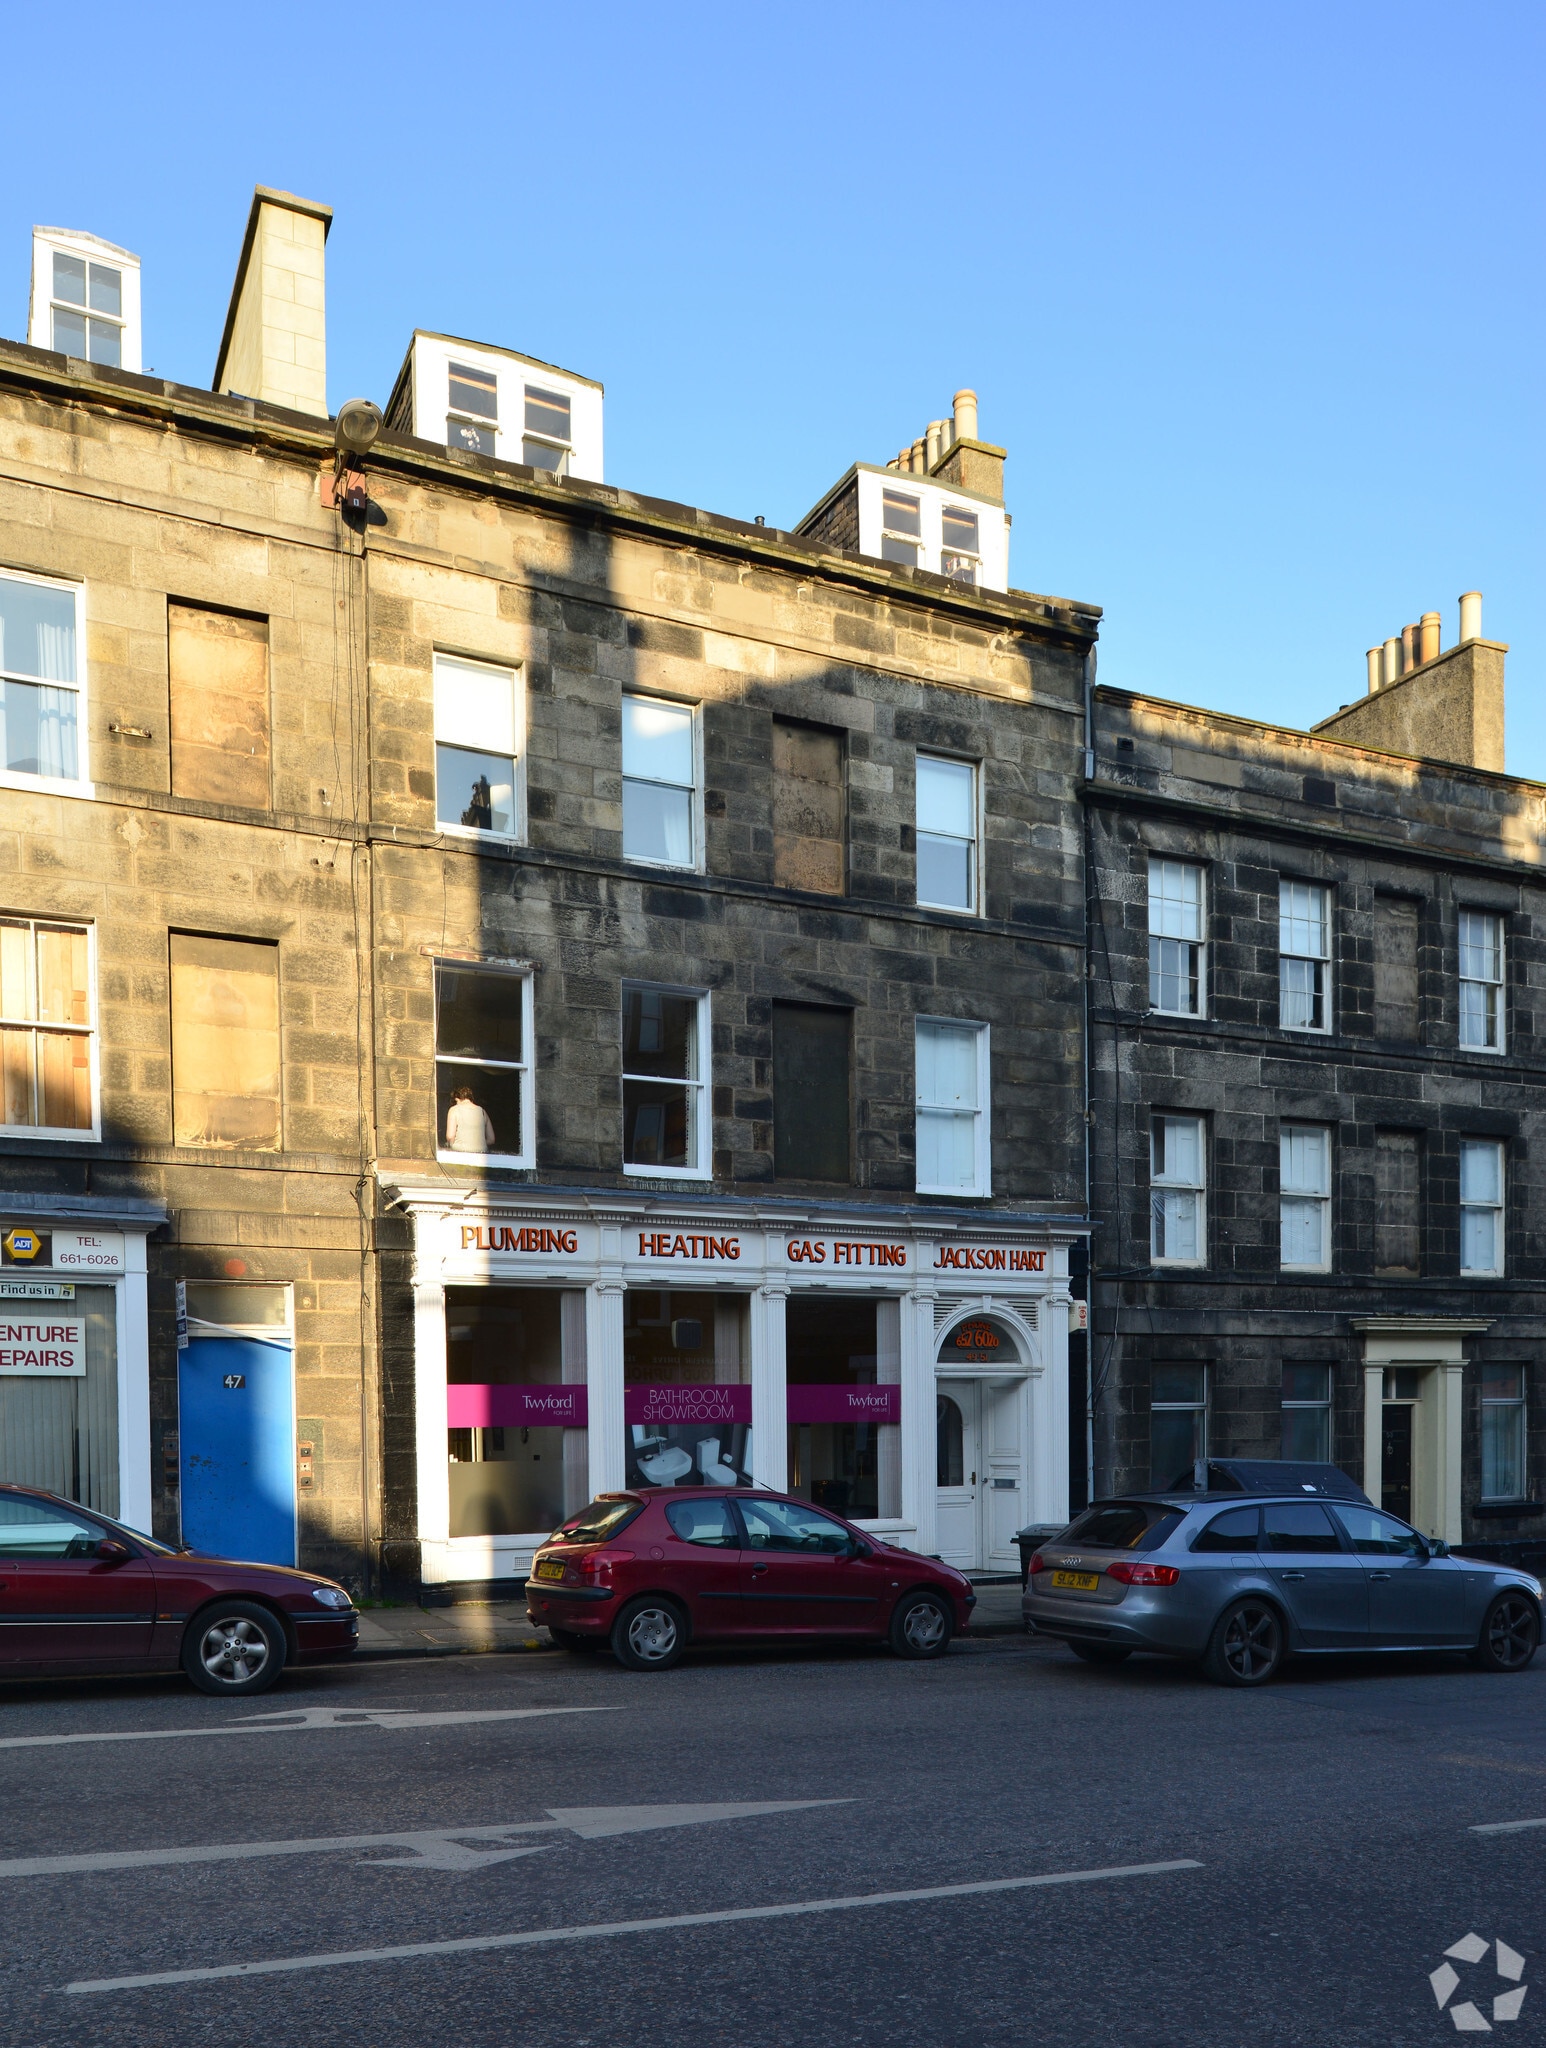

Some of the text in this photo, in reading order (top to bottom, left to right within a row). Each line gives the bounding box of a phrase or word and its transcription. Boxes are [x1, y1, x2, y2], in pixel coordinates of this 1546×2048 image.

[14, 1238, 32, 1249] ADT
[76, 1236, 102, 1247] TEL:
[461, 1226, 577, 1253] PLUMBING
[638, 1232, 741, 1260] HEATING
[59, 1253, 119, 1266] 661-6026
[787, 1239, 907, 1267] GAS FITTING
[933, 1246, 1047, 1272] JACKSON HART
[1, 1284, 55, 1295] Find us in
[955, 1328, 1000, 1348] 652 6020
[0, 1349, 74, 1368] EPAIRS
[224, 1375, 242, 1389] 47
[521, 1394, 572, 1412] Twyford
[649, 1389, 729, 1404] BATHROOM
[846, 1393, 888, 1409] Twyford
[643, 1404, 734, 1420] SHOWROOM
